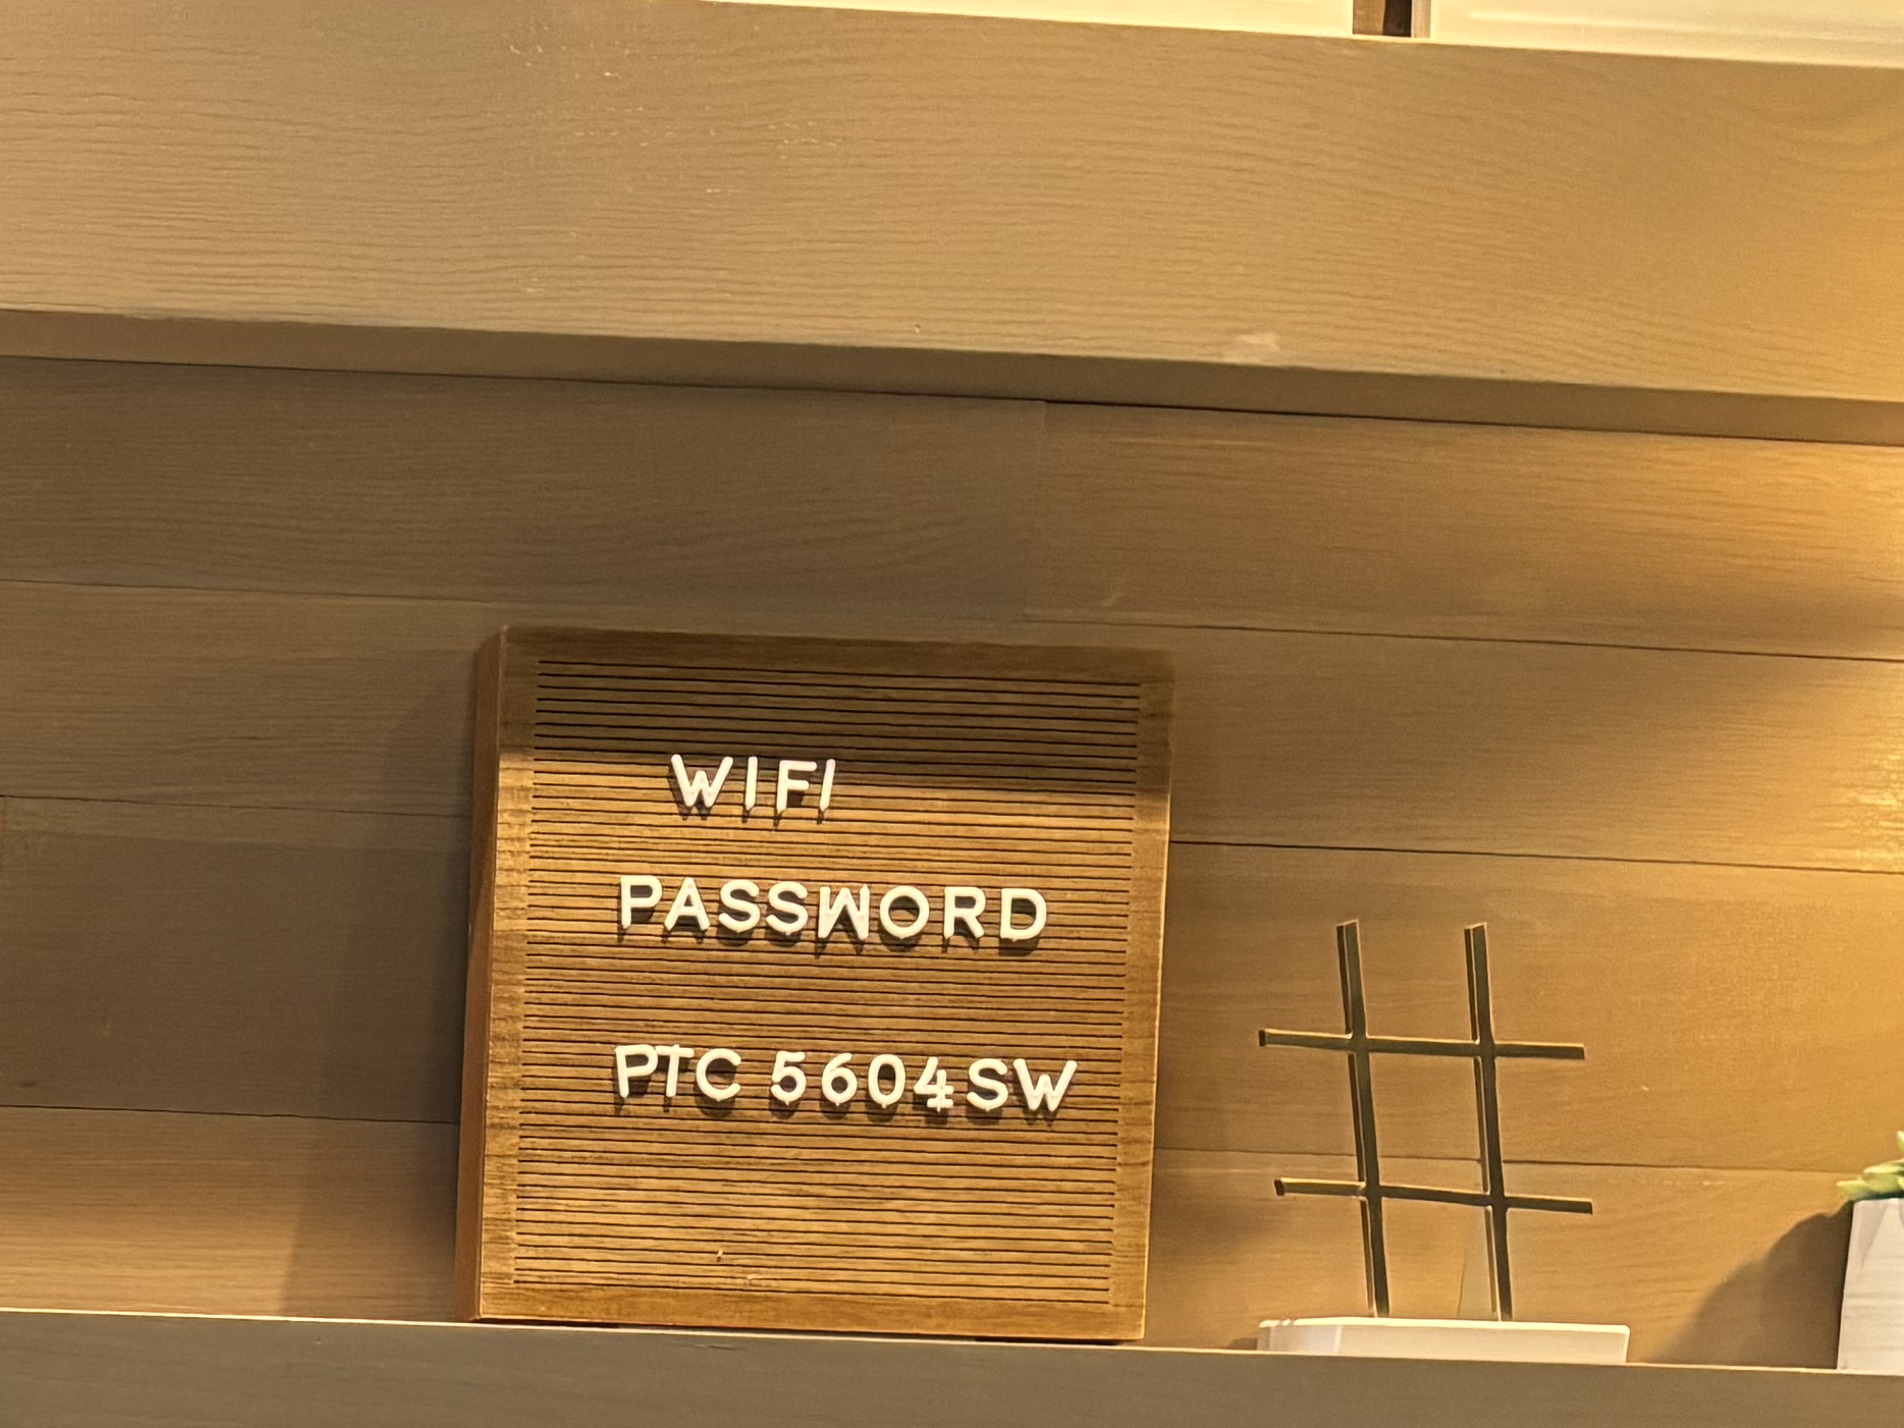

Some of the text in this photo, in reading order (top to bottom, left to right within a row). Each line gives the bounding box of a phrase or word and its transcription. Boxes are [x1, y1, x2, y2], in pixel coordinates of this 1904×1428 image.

[670, 754, 837, 812] WIFI
[619, 875, 1048, 941] PASSWORD
[614, 1044, 1078, 1113] PTC 5604SW
